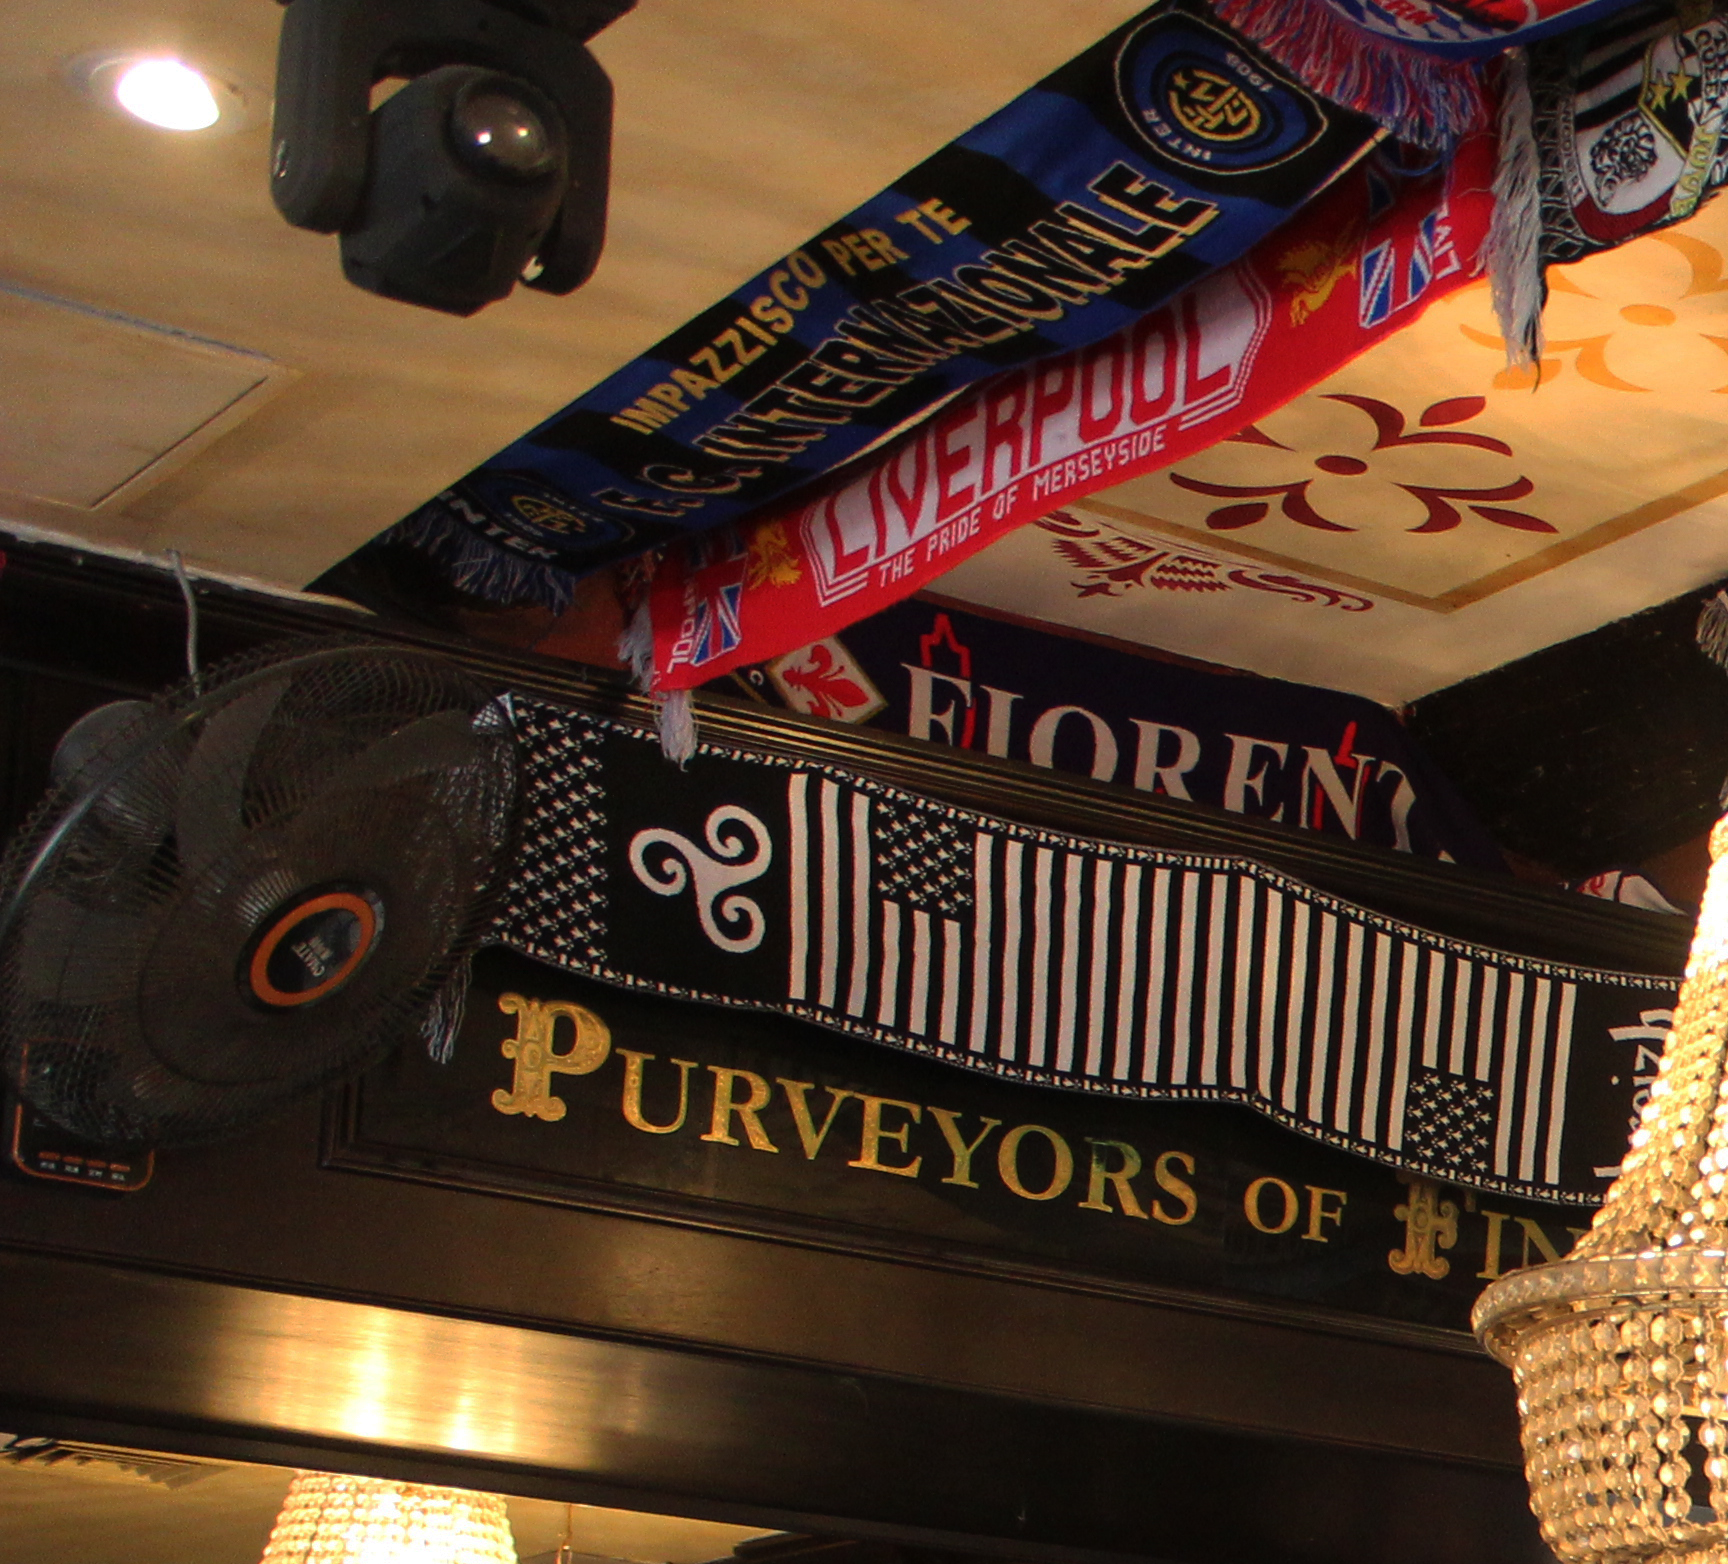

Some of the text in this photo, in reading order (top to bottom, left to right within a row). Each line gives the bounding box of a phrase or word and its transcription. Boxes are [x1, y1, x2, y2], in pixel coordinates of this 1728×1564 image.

[1140, 106, 1213, 162] INTER
[610, 197, 972, 436] IMPAZZISCO PER TE
[692, 158, 1224, 463] INTERNAZIONALE
[822, 298, 1235, 573] LIVERPOOL
[879, 427, 1167, 589] THE PRIDE OF MERSEYSIDE
[1243, 1175, 1348, 1244] OF
